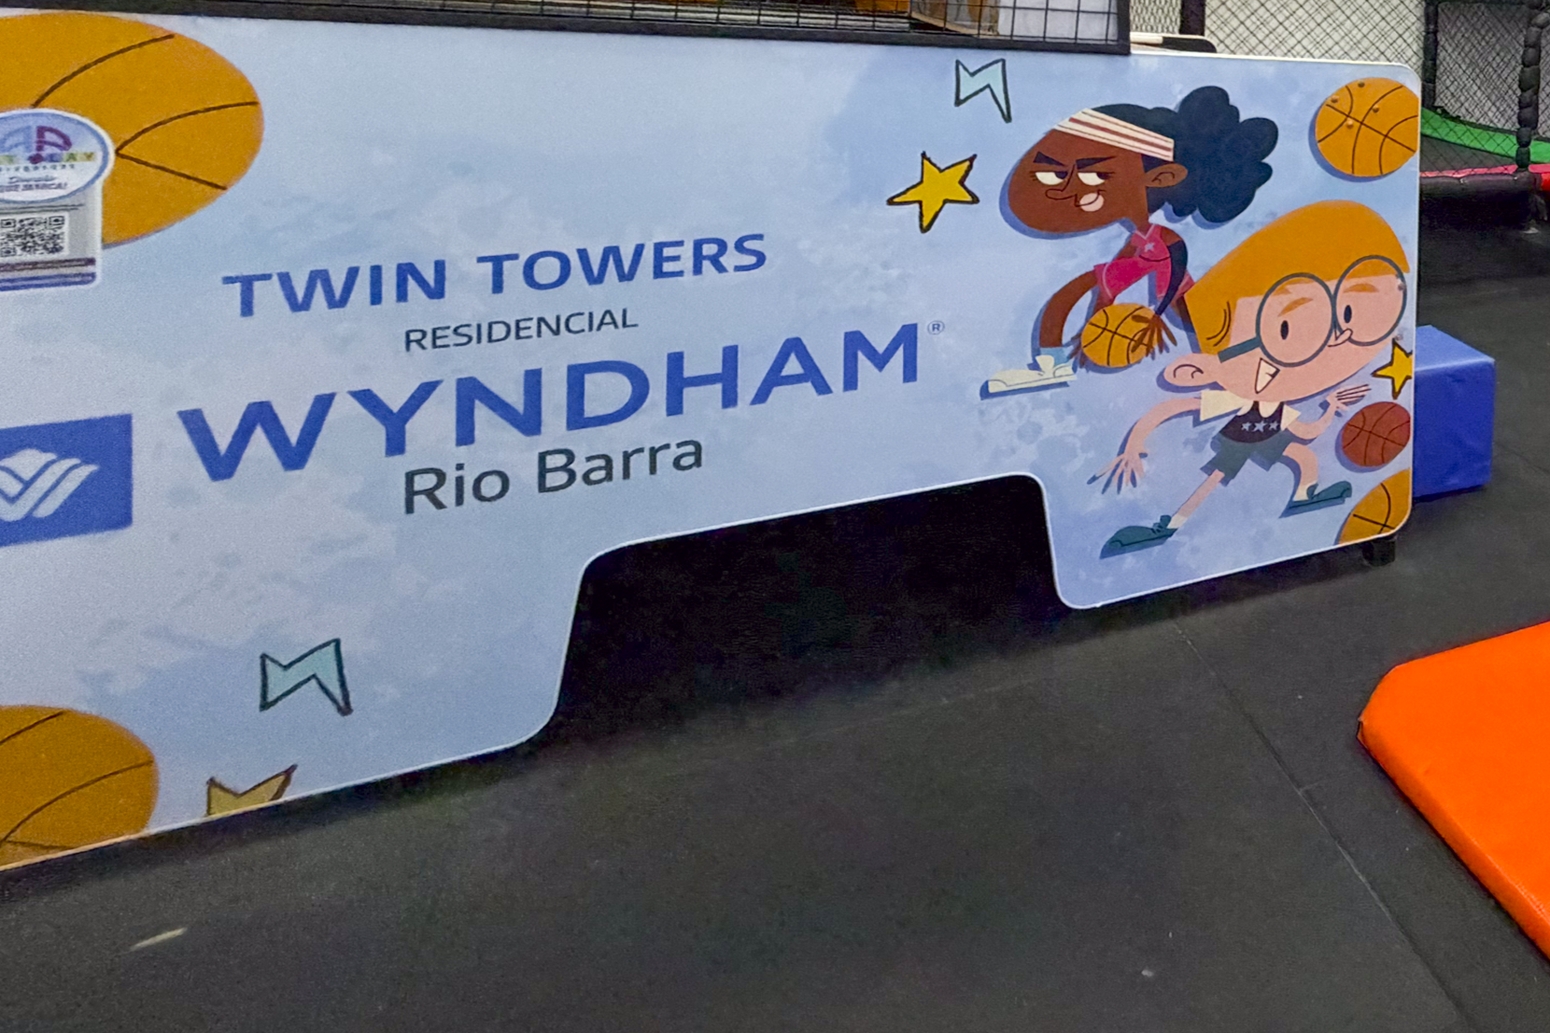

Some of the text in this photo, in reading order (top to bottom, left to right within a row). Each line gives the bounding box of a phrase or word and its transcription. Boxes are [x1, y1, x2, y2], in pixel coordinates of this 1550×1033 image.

[221, 232, 768, 318] TWIN TOWERS
[404, 307, 639, 353] RESIDENCIAL
[404, 439, 704, 516] Rio Barra
